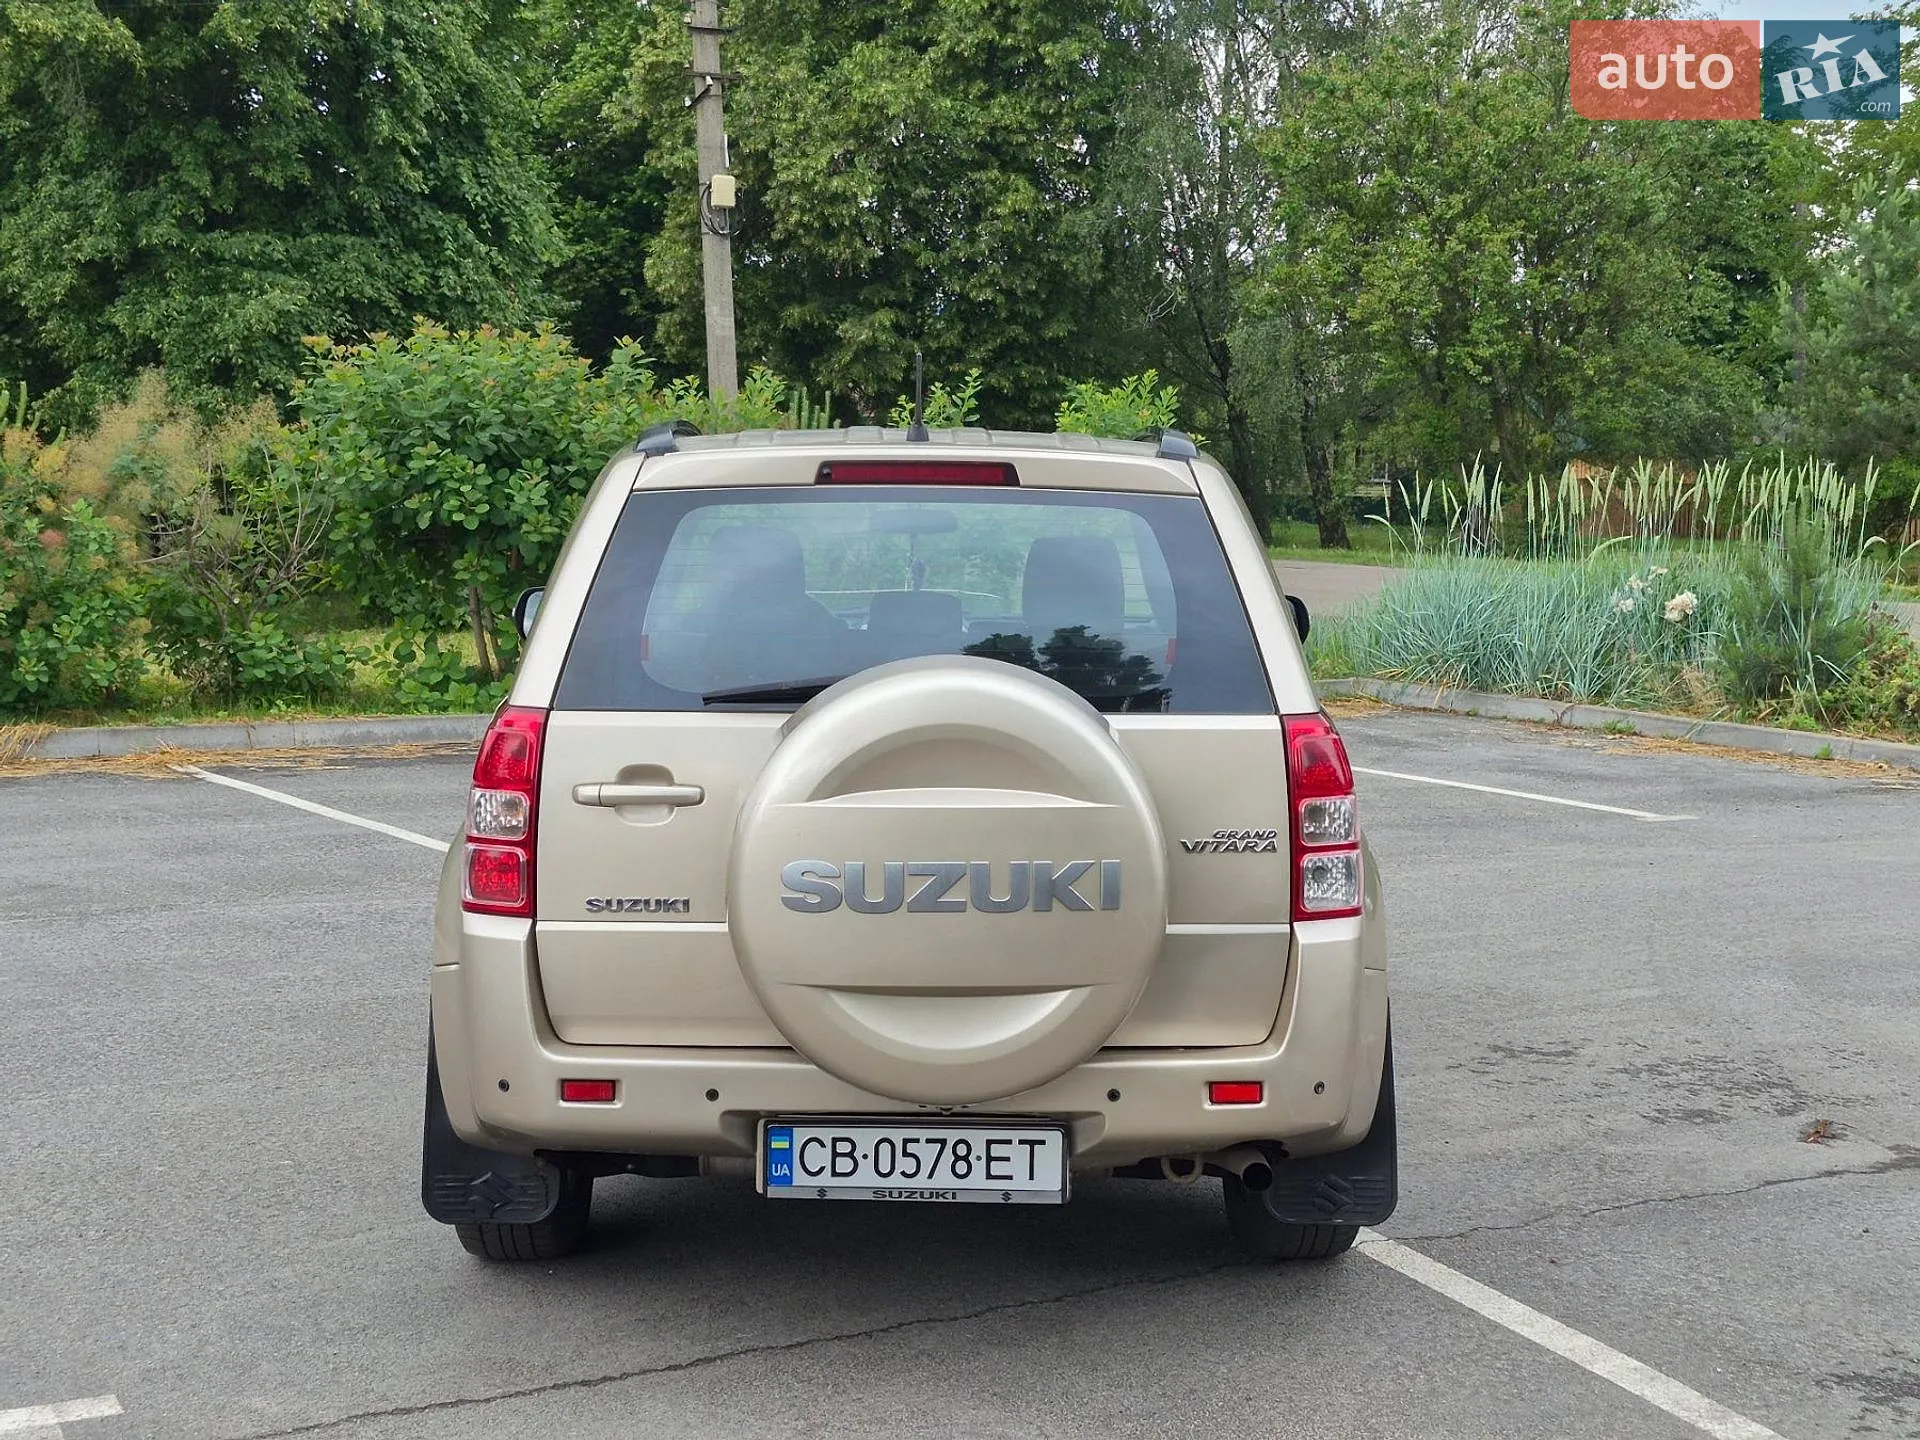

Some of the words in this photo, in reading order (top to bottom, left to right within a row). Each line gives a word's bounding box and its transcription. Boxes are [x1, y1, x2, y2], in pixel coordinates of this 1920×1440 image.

[1213, 829, 1278, 840] GRAND
[1180, 839, 1277, 853] VITARA
[781, 859, 1121, 914] SUZUKI
[585, 896, 690, 913] SUZUKI
[772, 1163, 790, 1177] UA
[872, 1190, 957, 1200] SUZUKI
